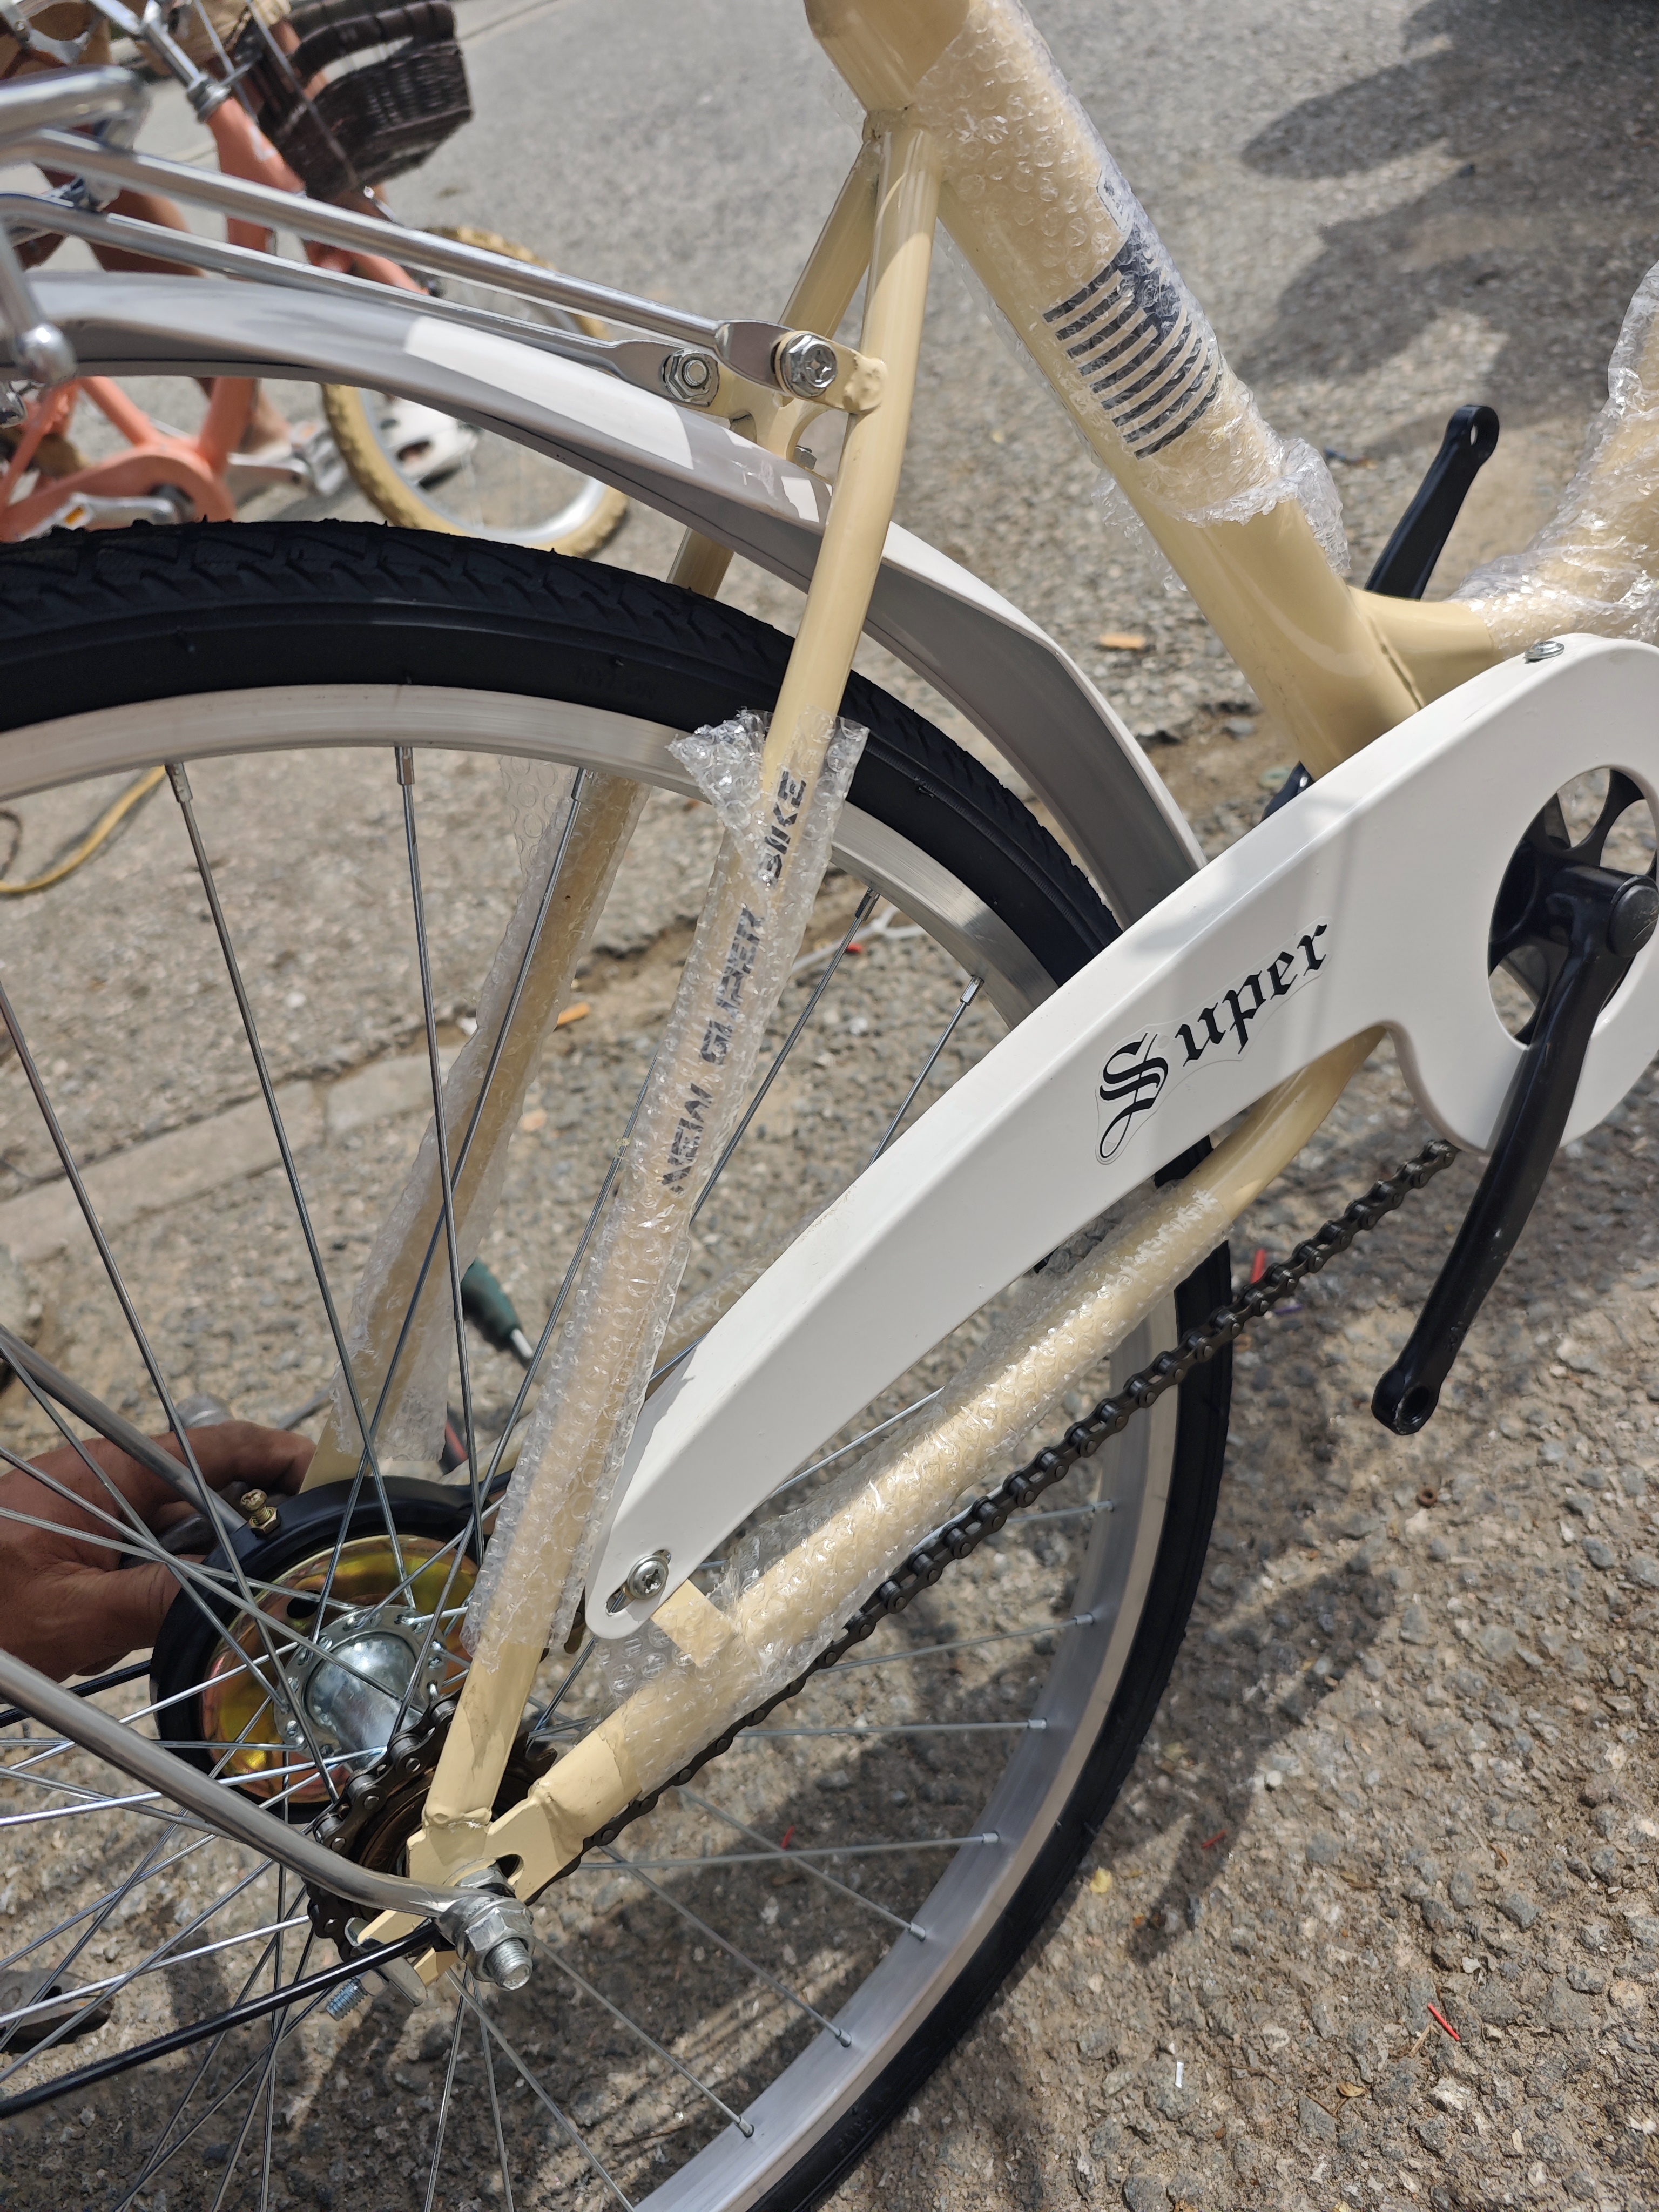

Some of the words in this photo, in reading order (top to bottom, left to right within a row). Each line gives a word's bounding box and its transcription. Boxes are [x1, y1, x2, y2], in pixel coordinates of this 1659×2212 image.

[661, 1082, 713, 1193] NEW
[759, 770, 807, 888] BIKE
[1100, 924, 1327, 1158] Super
